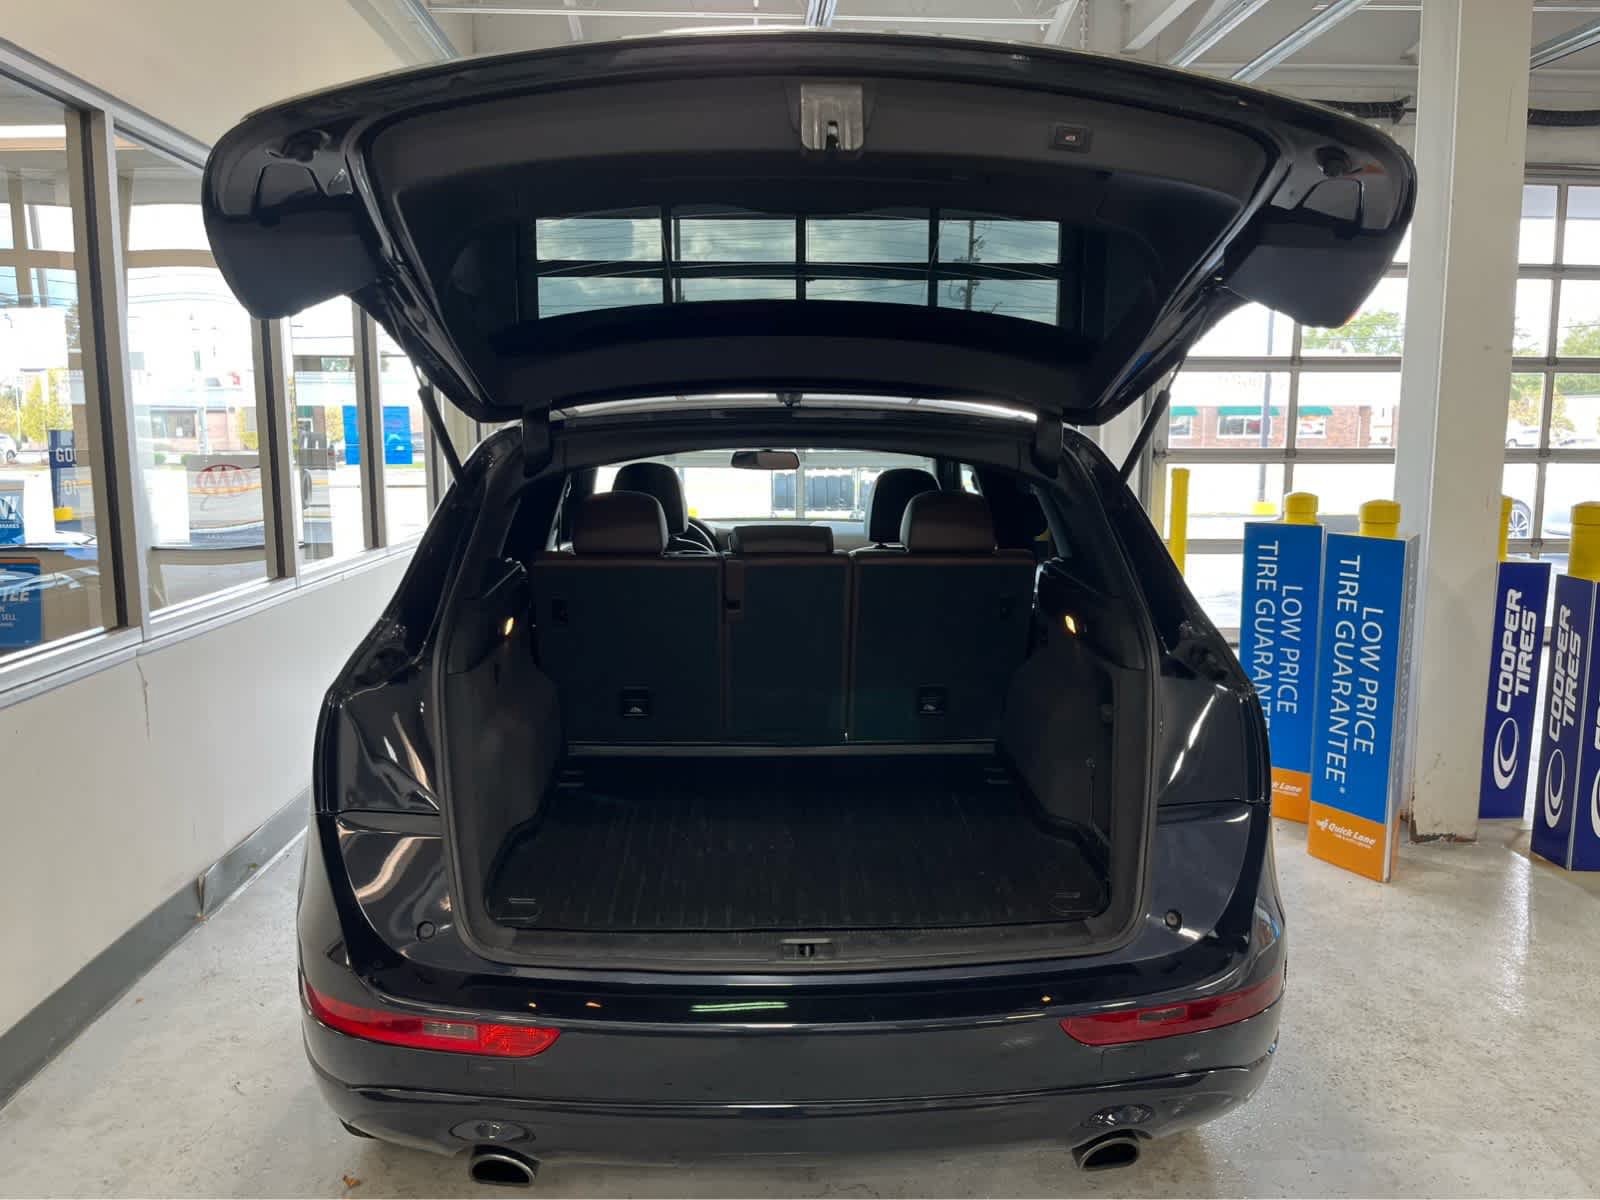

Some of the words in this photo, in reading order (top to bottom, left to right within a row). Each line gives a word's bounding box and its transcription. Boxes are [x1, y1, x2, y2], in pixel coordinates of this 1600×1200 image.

[1256, 540, 1279, 592] TIRE
[1336, 555, 1361, 613] TIRE
[1280, 585, 1303, 641] LOW
[1359, 607, 1384, 672] LOW
[1253, 599, 1276, 736] GUARANT
[1277, 647, 1300, 714] PRICE
[1496, 588, 1522, 713] COOPER
[1515, 610, 1537, 697] TIRES
[1549, 604, 1571, 742] COOPER
[1563, 629, 1582, 727] TIRES
[1353, 677, 1379, 755] PRICE
[1328, 823, 1354, 838] Quick
[1352, 831, 1377, 846] Lane
